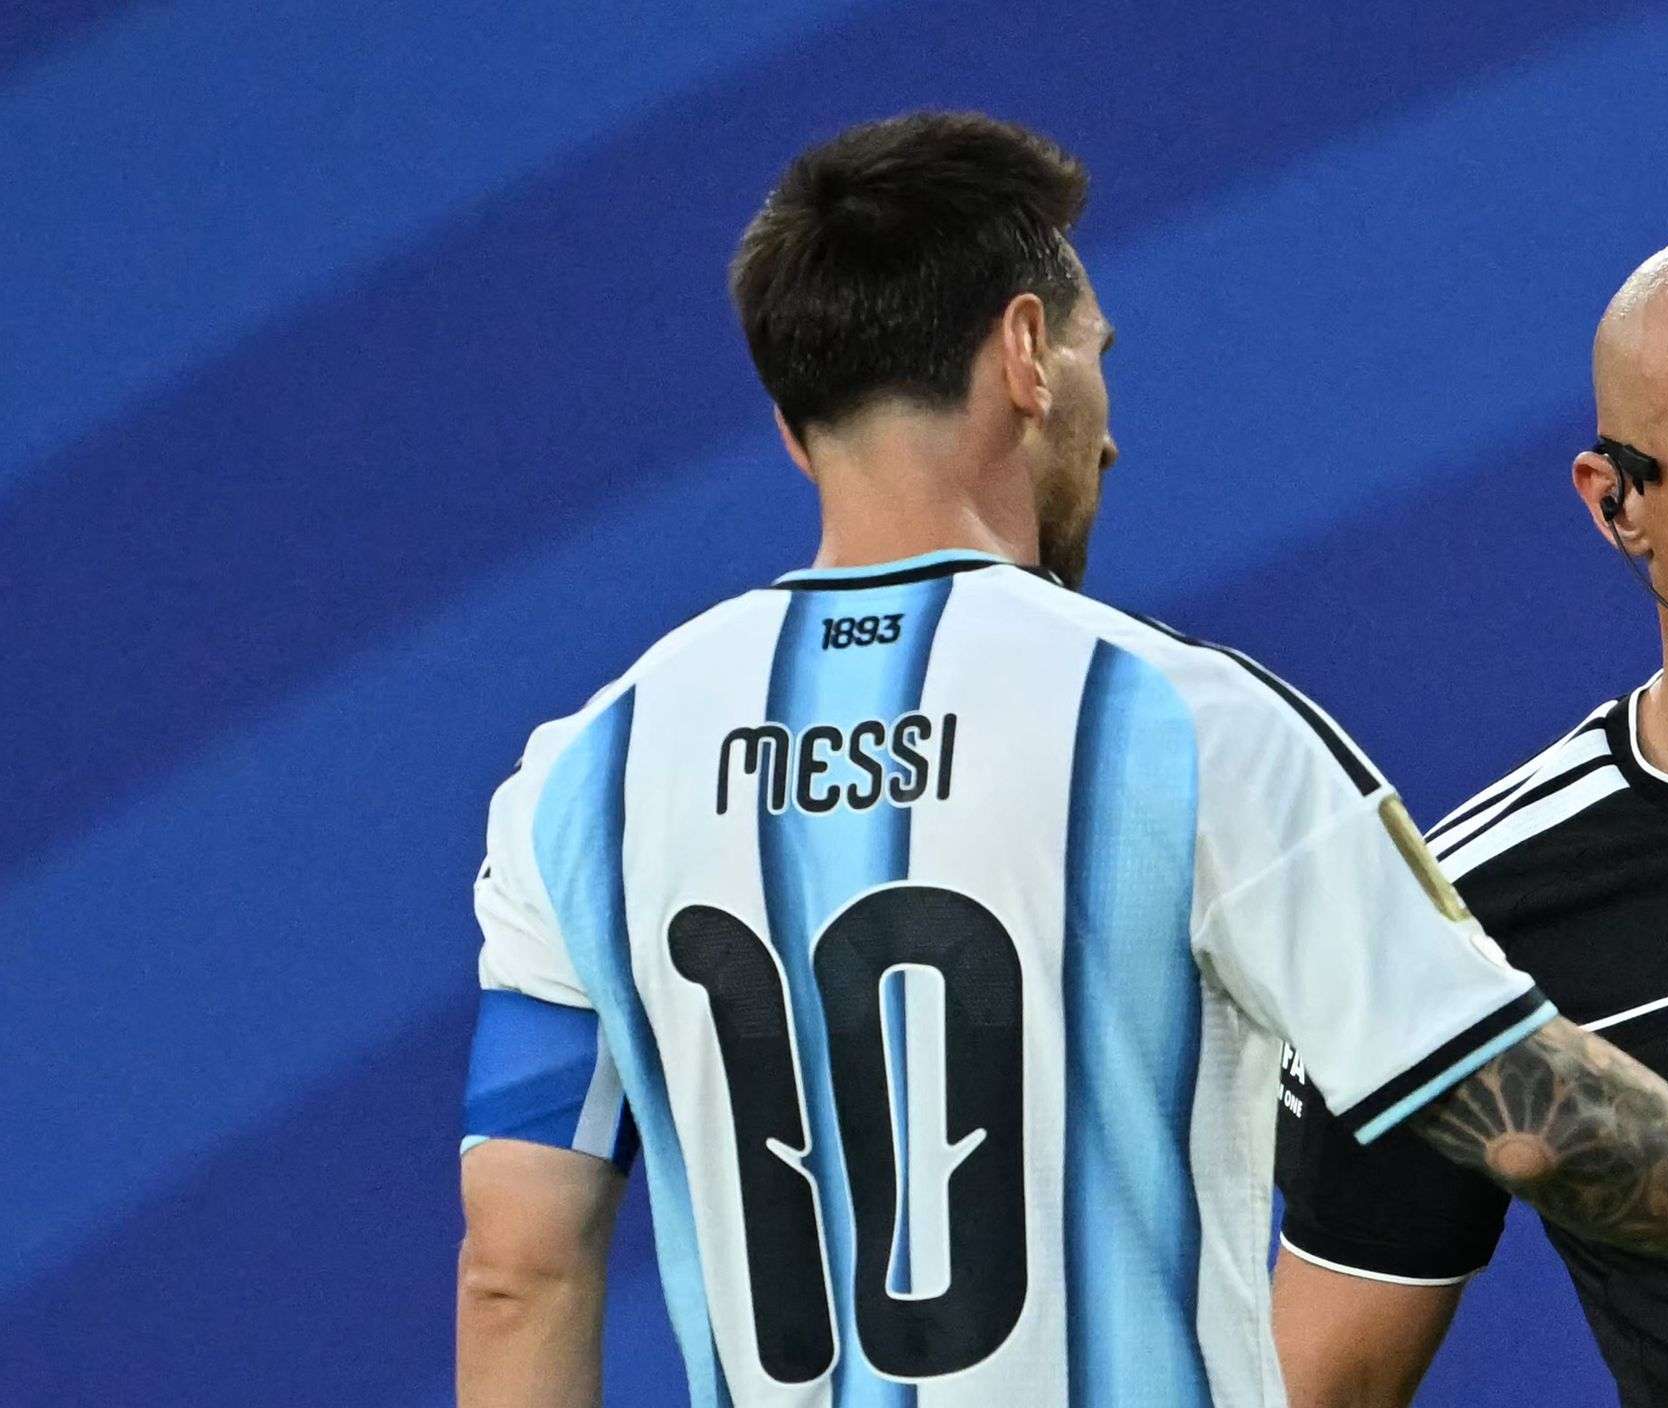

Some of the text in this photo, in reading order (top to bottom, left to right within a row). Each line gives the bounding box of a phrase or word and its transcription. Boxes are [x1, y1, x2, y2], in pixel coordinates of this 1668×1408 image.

[822, 614, 904, 650] 1893
[716, 713, 957, 815] MESSI
[666, 886, 1026, 1384] 10
